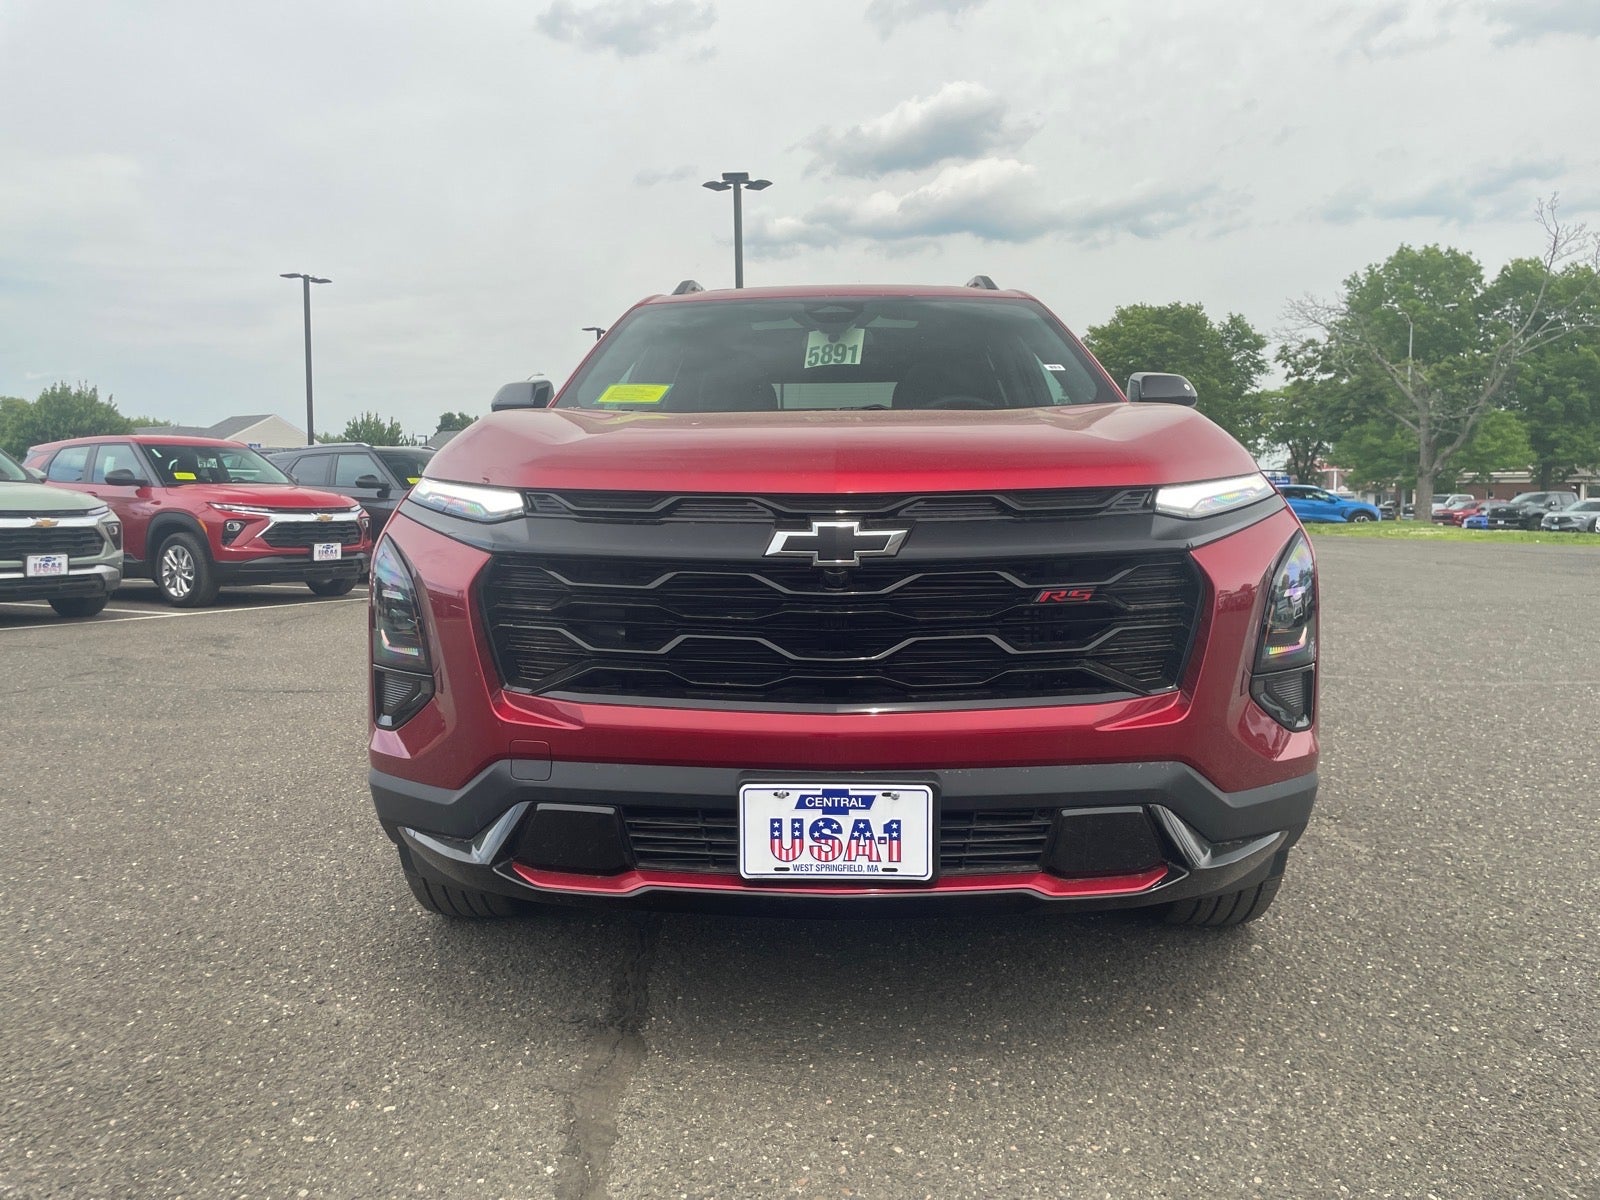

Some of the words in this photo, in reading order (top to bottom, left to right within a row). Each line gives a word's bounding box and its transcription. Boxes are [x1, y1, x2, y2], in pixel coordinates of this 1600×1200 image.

[807, 343, 858, 366] 5891
[1036, 588, 1095, 603] RS
[805, 797, 866, 808] CENTRAL
[769, 817, 902, 863] USA-1
[792, 864, 814, 872] WEST
[867, 864, 879, 873] MA
